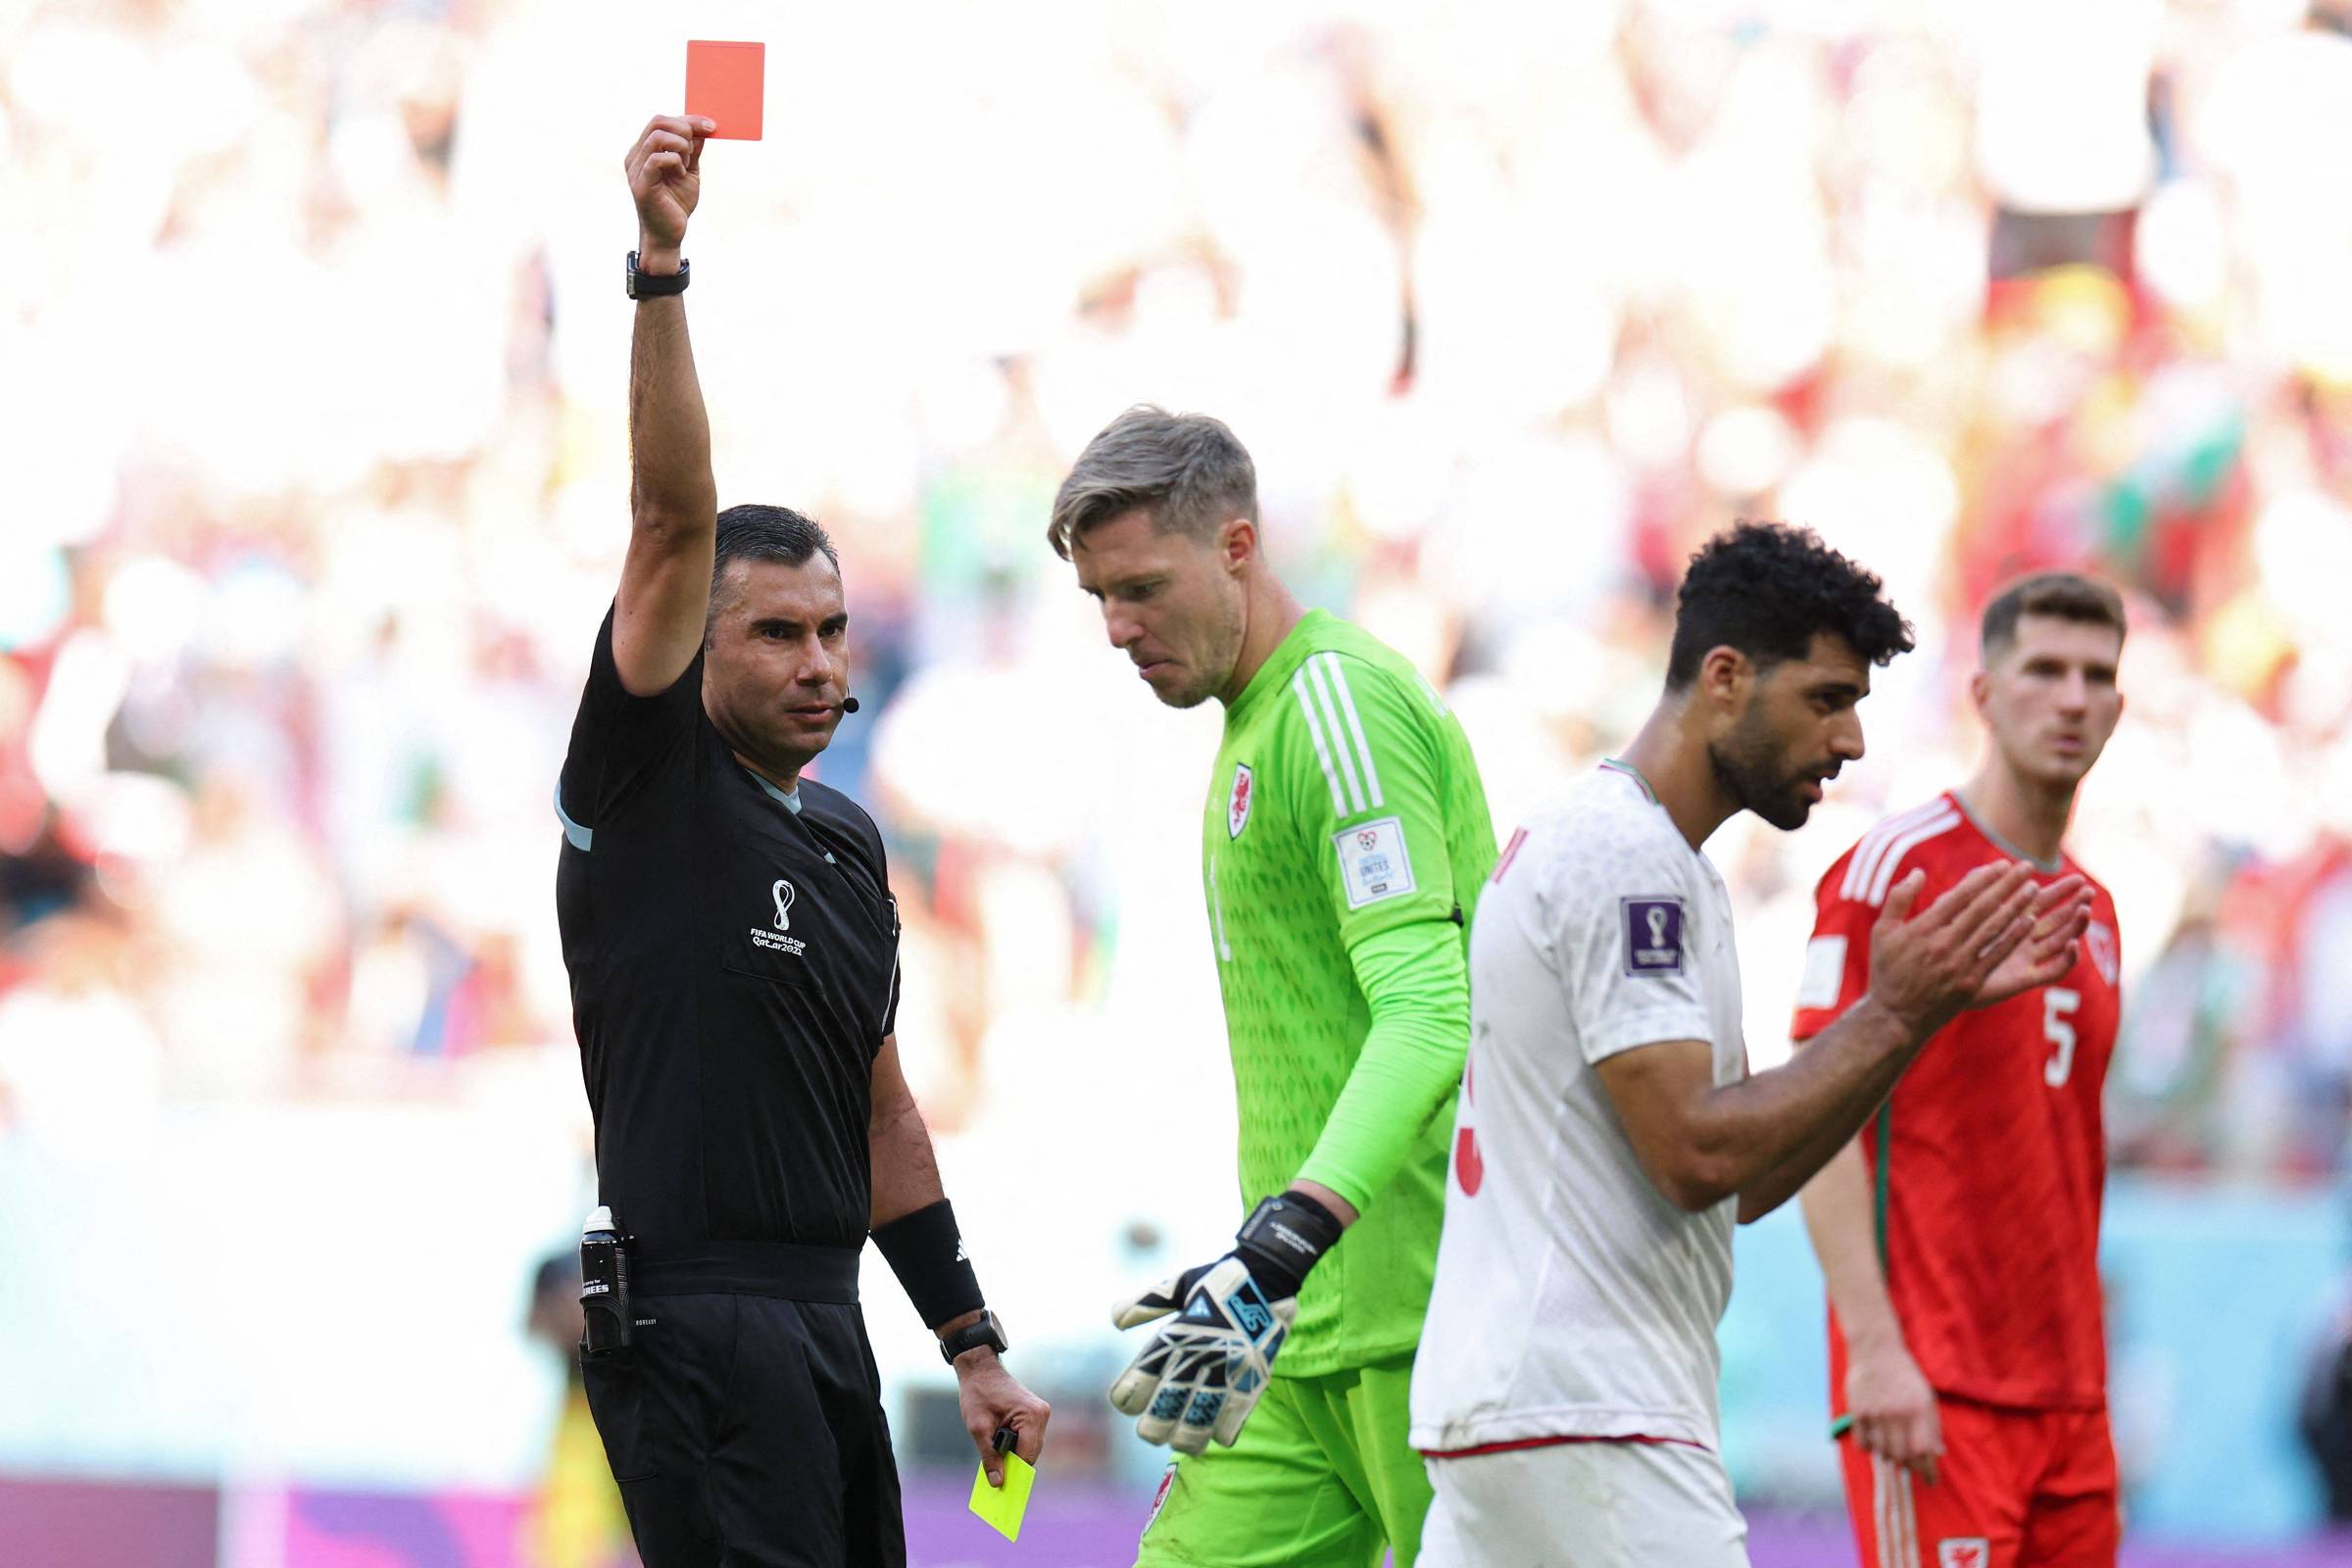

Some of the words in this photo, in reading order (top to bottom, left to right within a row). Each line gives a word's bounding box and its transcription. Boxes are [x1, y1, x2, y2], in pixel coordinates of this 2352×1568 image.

[750, 927, 767, 938] FIFA
[767, 931, 793, 944] WORLD
[794, 939, 807, 949] CUP
[2042, 988, 2081, 1088] 5
